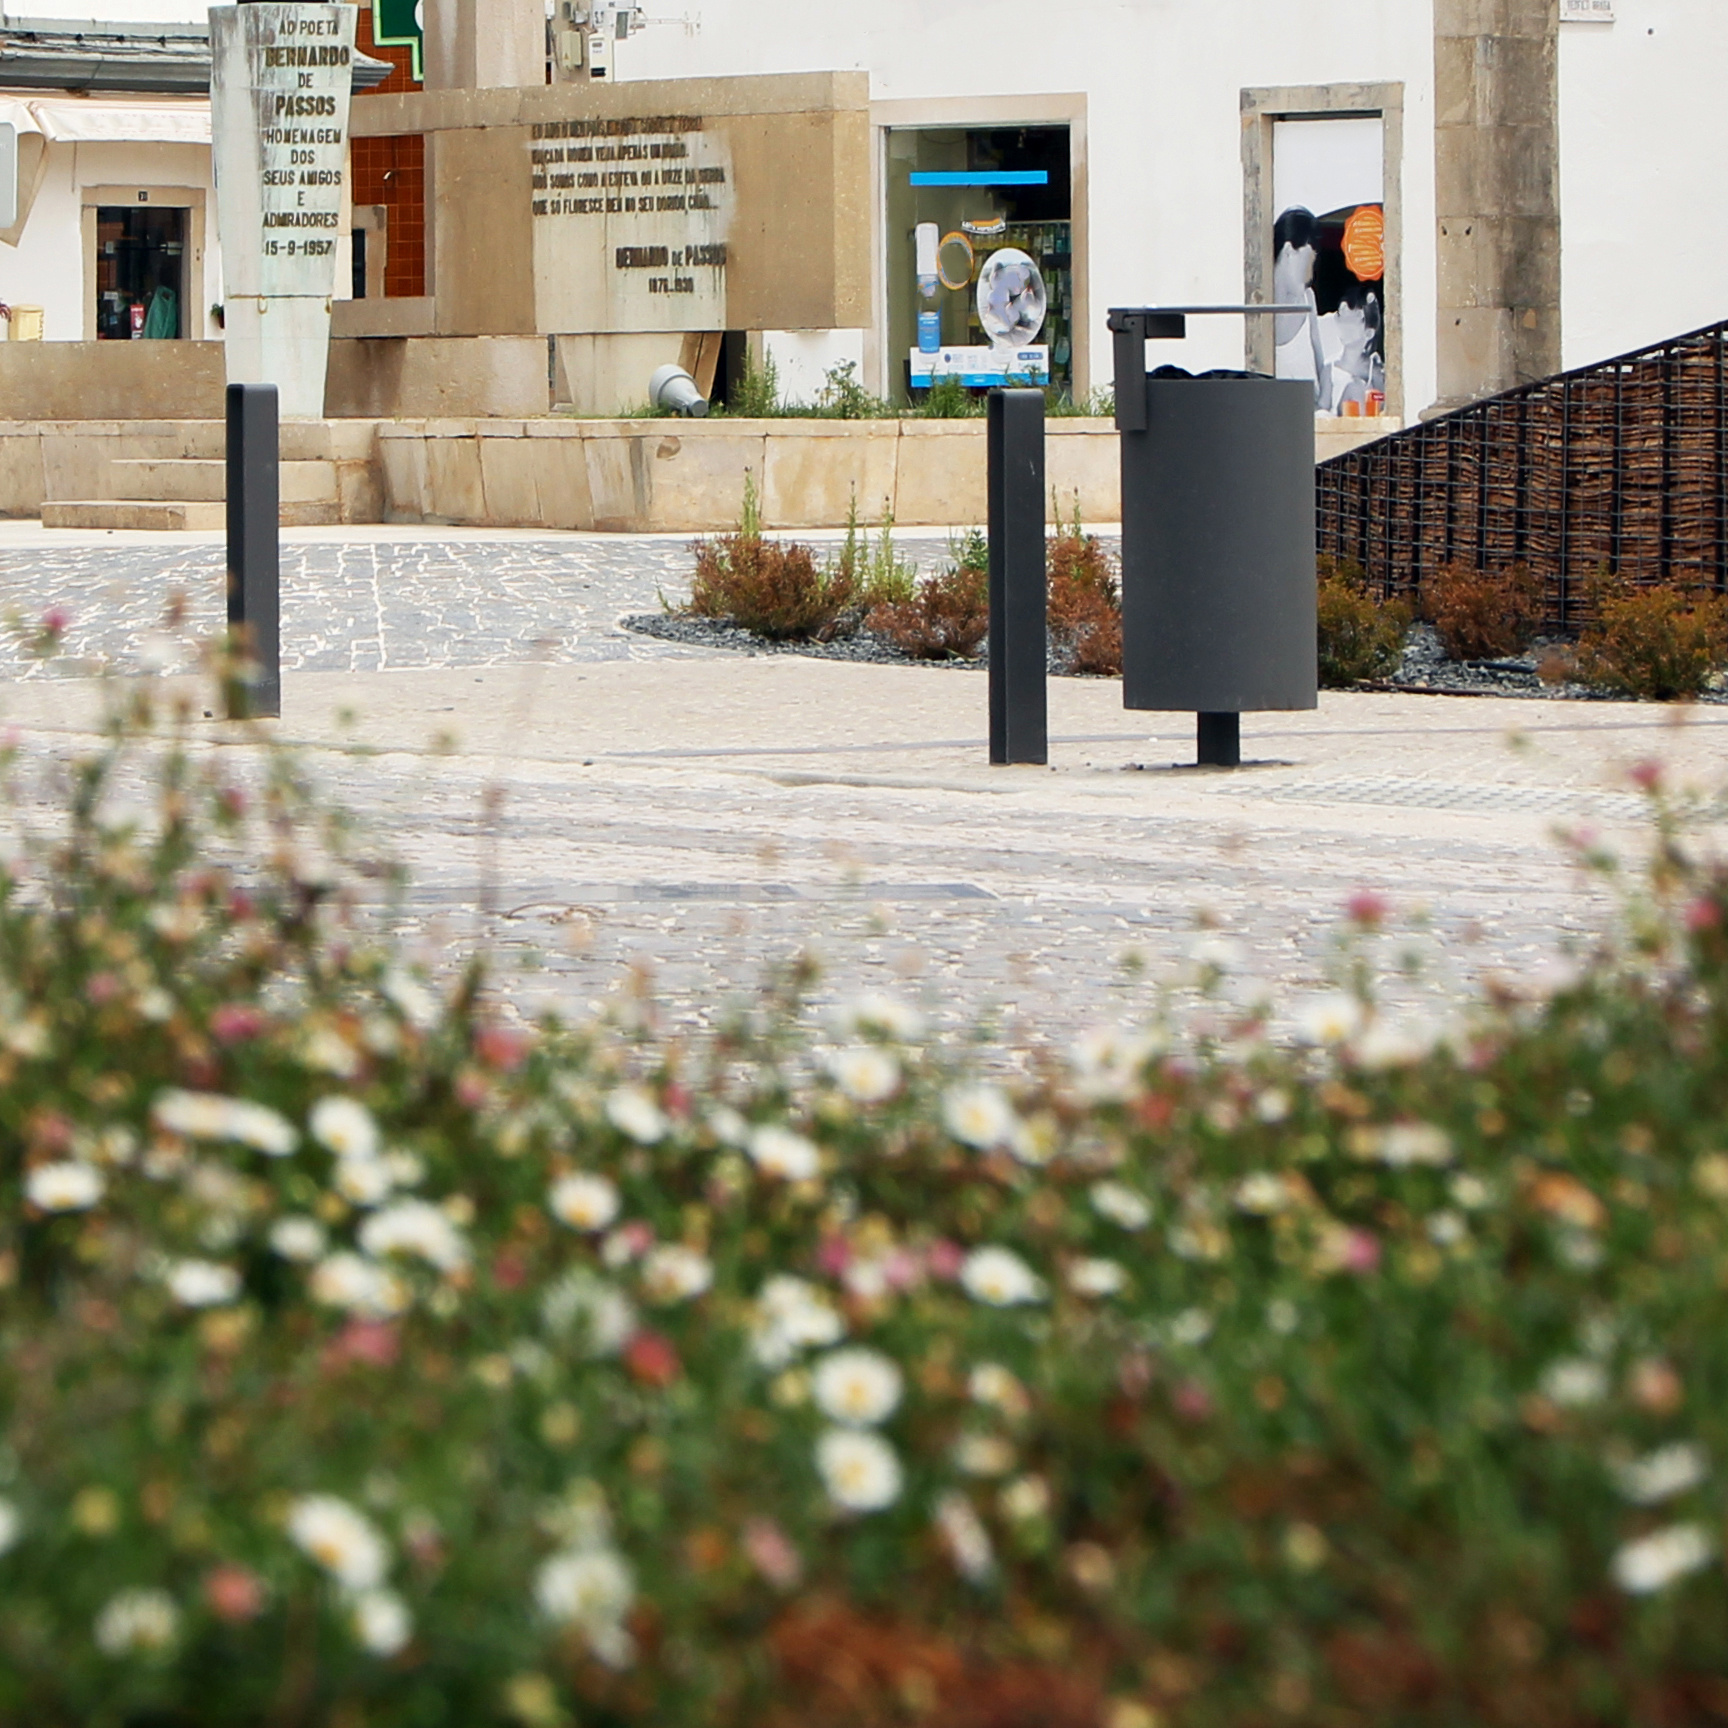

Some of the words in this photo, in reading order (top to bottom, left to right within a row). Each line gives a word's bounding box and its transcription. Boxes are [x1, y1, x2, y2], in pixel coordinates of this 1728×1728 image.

[299, 19, 339, 35] POETA
[265, 45, 350, 67] BERNARDO
[298, 73, 313, 88] DE
[275, 95, 336, 116] PASSOS
[266, 128, 341, 144] HOMENAGEM
[290, 150, 315, 165] DOS
[263, 171, 295, 186] SEUS
[298, 170, 342, 186] AMIGOS
[297, 191, 305, 206] E
[262, 212, 338, 228] ADMIRADORES
[265, 239, 333, 256] 15-9-1957
